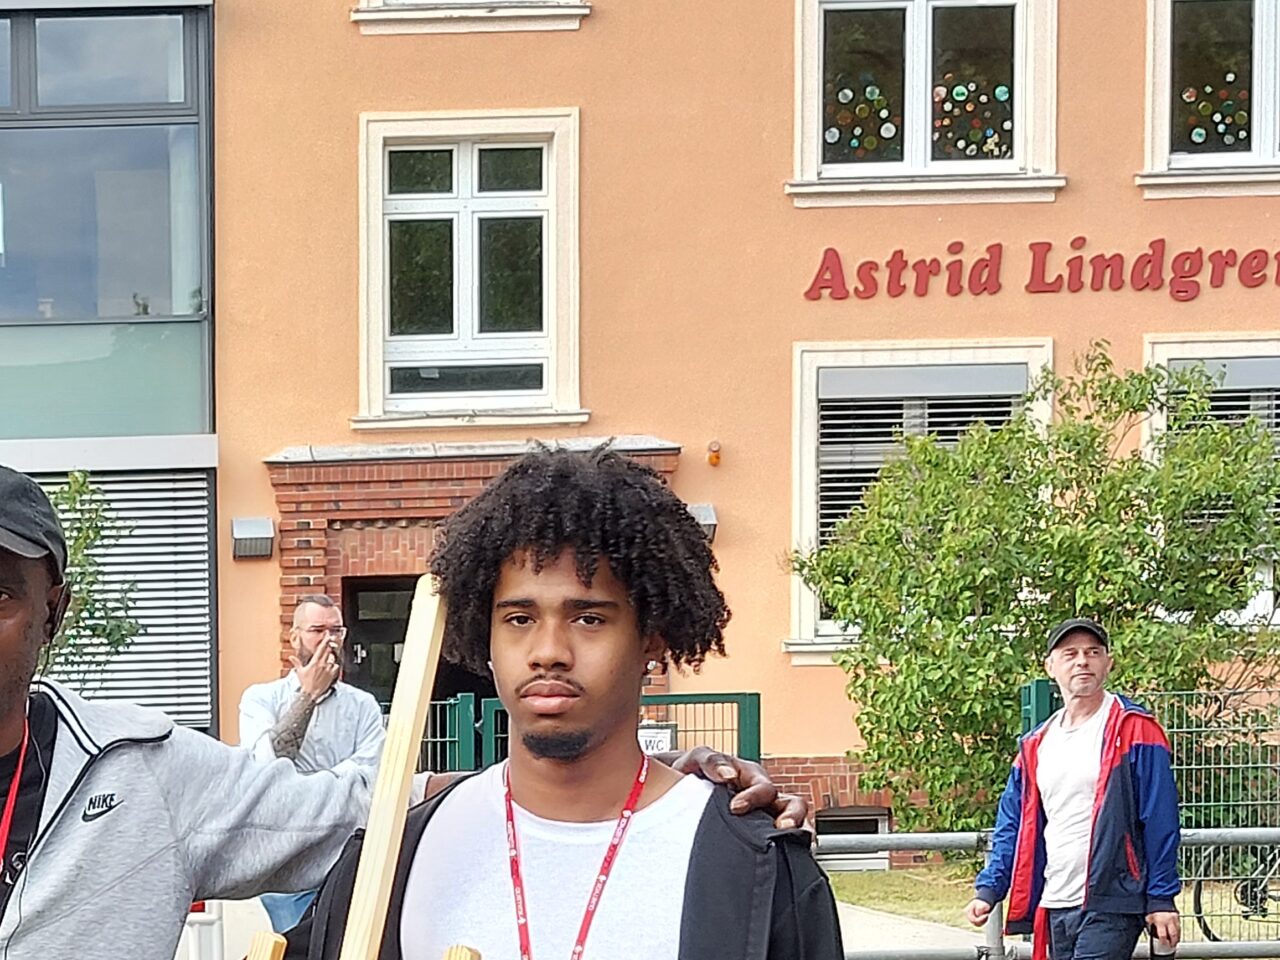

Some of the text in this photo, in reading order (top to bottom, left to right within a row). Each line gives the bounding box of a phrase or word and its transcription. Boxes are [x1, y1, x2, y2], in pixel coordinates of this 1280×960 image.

[805, 236, 1280, 301] Astrid Lindgre
[644, 739, 664, 751] WC
[88, 793, 116, 811] NIKE
